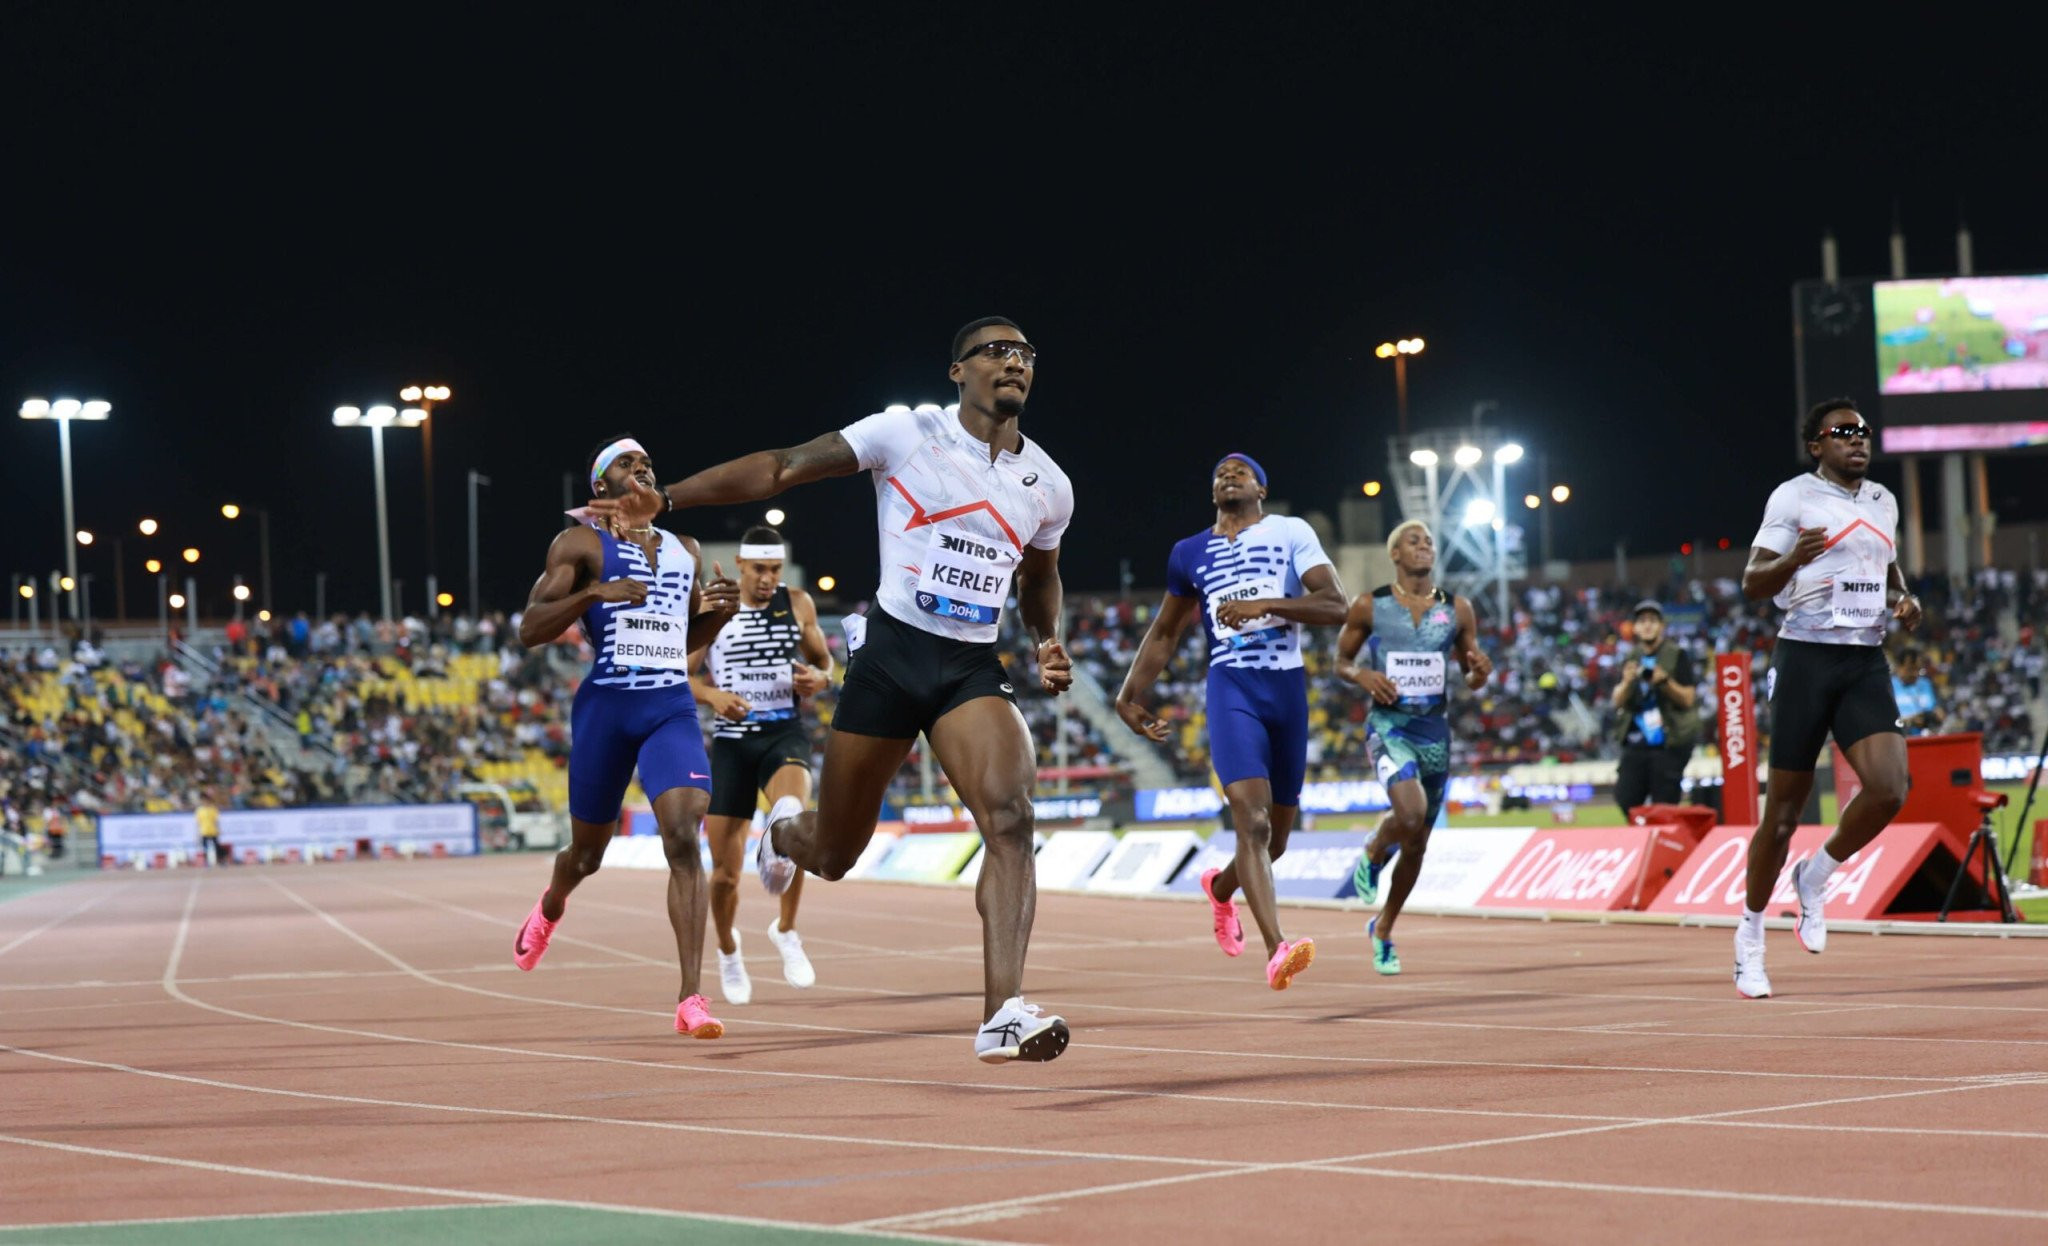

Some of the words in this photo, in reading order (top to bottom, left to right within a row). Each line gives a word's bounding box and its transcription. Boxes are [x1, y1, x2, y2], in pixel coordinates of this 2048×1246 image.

[939, 533, 998, 560] NITRO
[931, 563, 1004, 594] KERLEY
[1840, 582, 1880, 592] NITRO
[1217, 587, 1258, 604] NITRO
[948, 604, 980, 619] DOHA
[622, 618, 670, 632] NITRO
[617, 643, 684, 660] BEDNAREK
[1395, 658, 1431, 667] NITRO
[740, 672, 777, 681] NITRO
[1724, 690, 1745, 769] OMEGA
[1526, 847, 1640, 900] OMEGA
